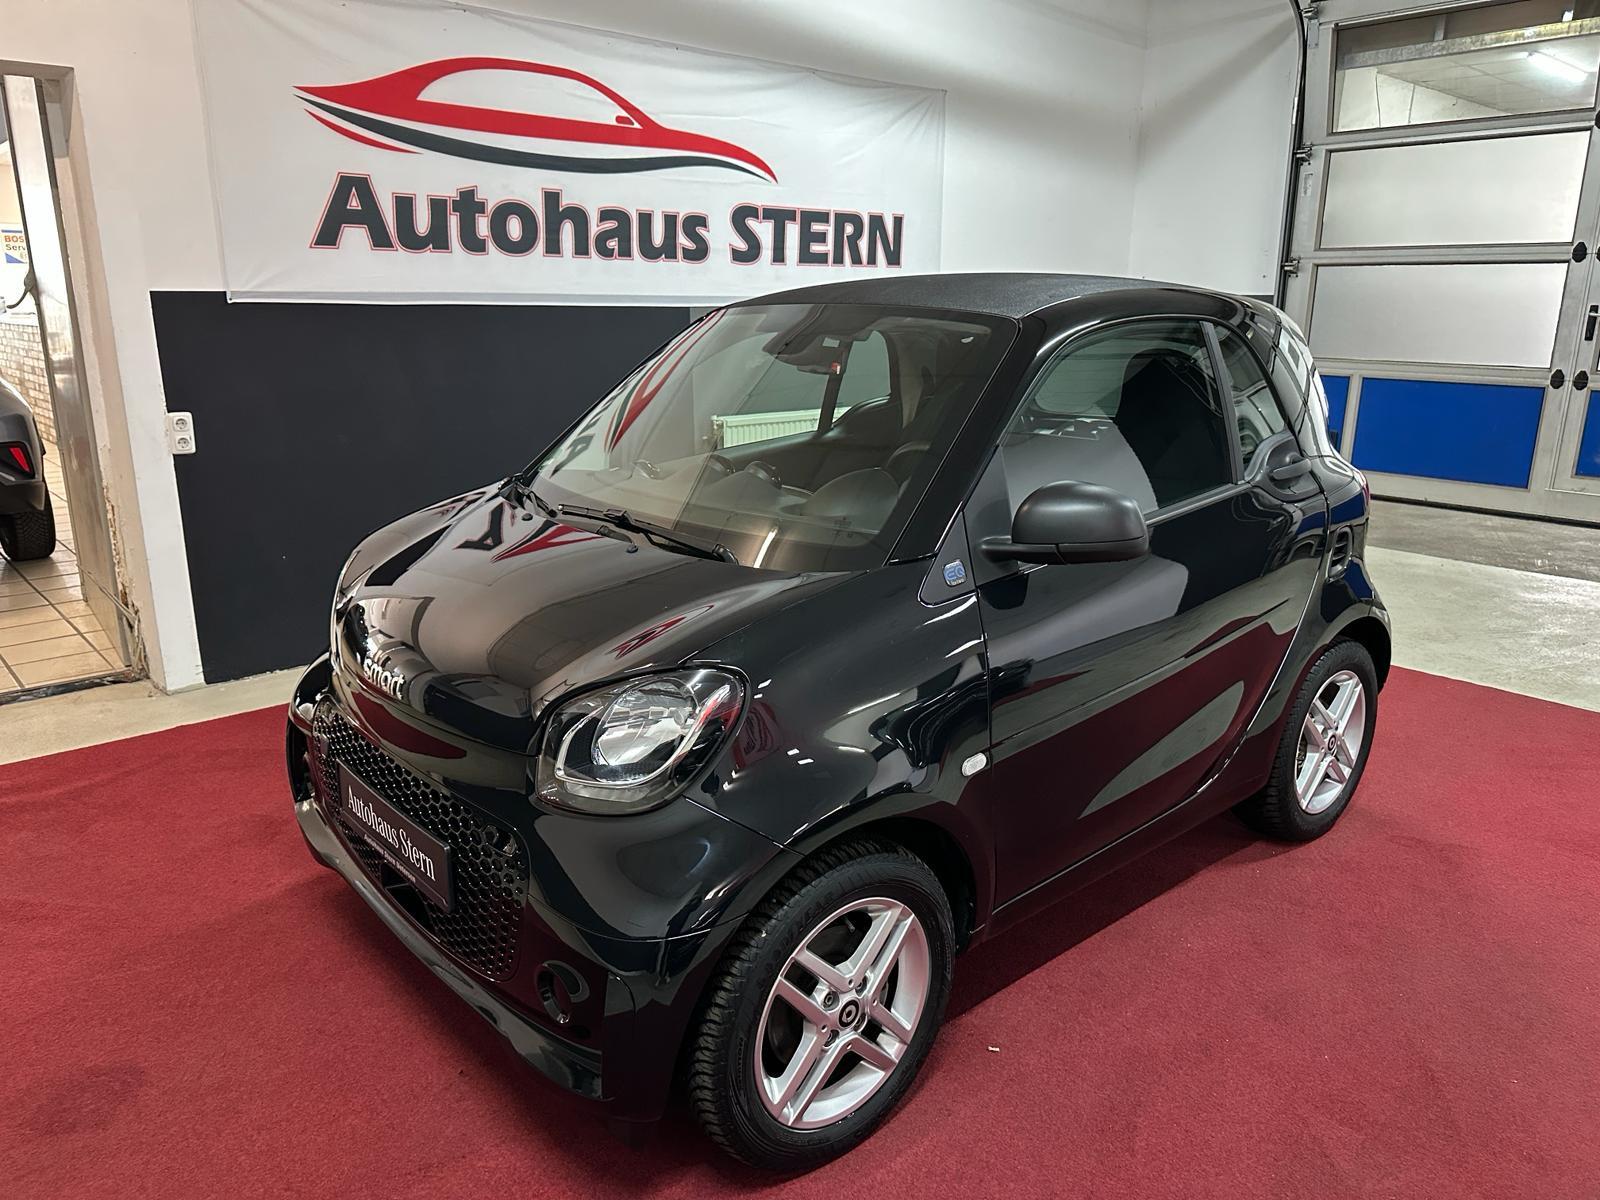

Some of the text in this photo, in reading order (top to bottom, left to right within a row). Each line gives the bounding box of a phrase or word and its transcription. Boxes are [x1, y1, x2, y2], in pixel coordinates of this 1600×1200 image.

[309, 171, 905, 269] Autohaus STERN
[363, 658, 405, 700] smart
[348, 784, 399, 849] Autohaus
[399, 828, 436, 882] Stern
